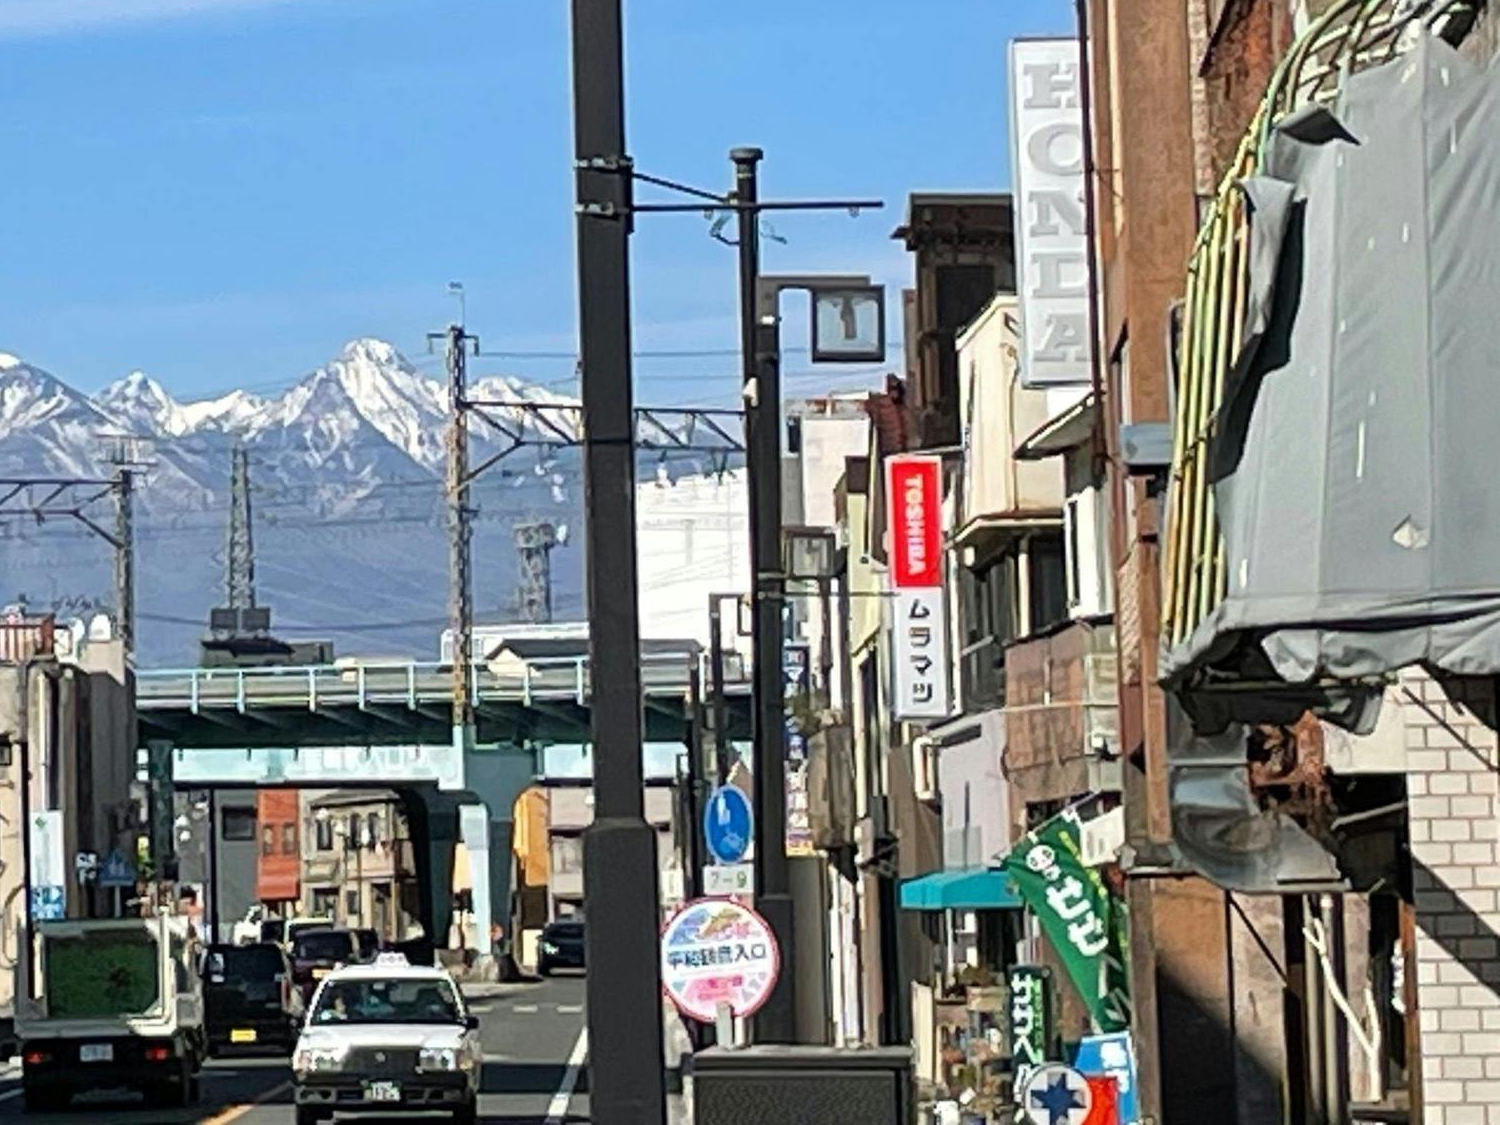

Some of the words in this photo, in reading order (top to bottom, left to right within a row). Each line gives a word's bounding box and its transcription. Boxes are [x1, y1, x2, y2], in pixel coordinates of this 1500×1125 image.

[1023, 62, 1091, 364] HONDA
[905, 472, 927, 575] TOSHIBA
[909, 598, 934, 704] ムラマツ
